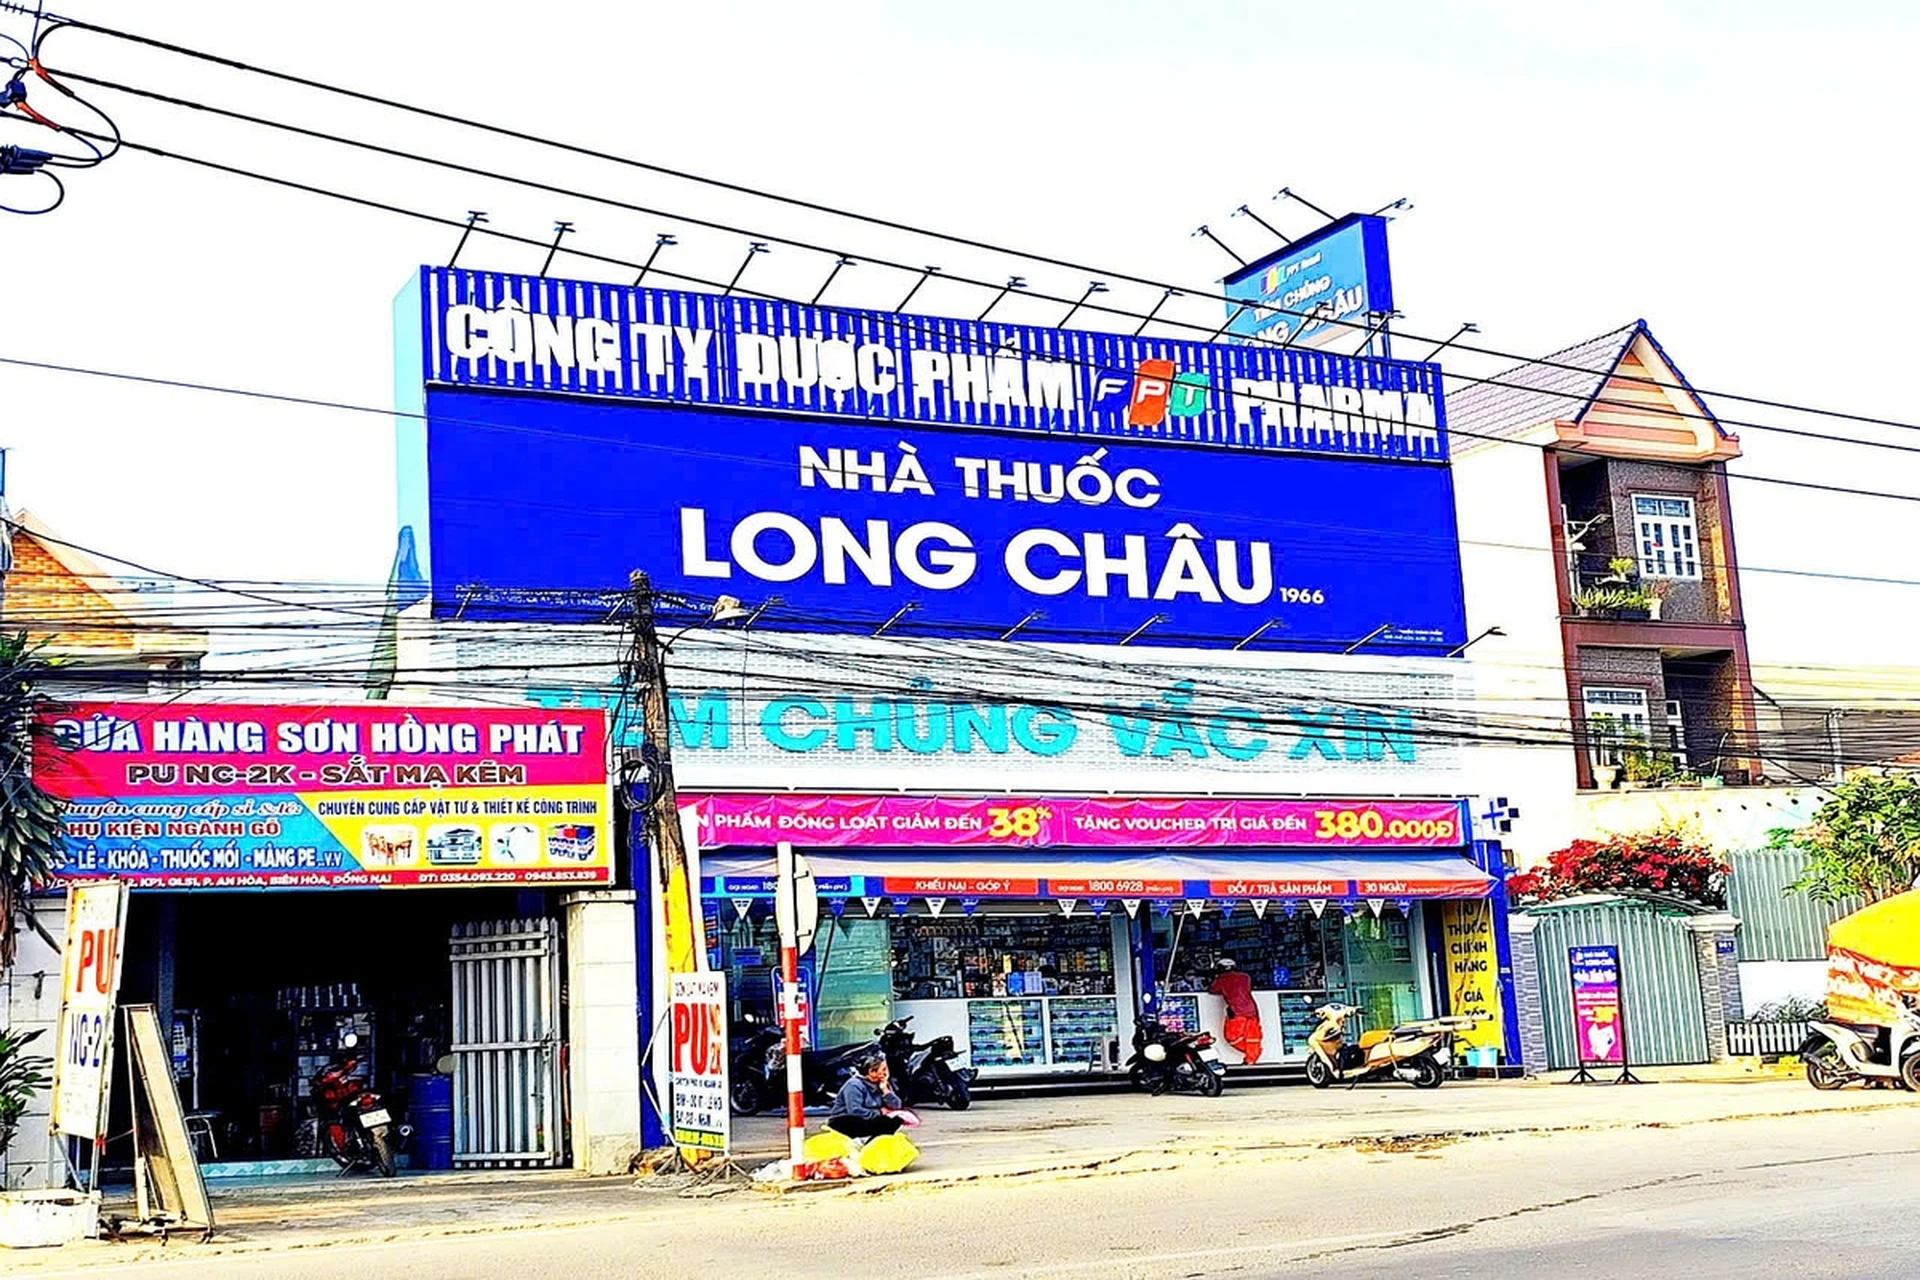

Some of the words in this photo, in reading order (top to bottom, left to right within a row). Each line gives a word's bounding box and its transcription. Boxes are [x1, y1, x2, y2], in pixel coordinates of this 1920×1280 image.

[446, 298, 620, 373] CÔNG
[631, 323, 713, 379] TY
[911, 337, 1075, 411] PHẨM
[1231, 378, 1437, 438] PHARMA
[799, 441, 935, 496] NHÀ
[955, 447, 1161, 508] THUỐC
[679, 507, 977, 590] LONG
[1003, 522, 1274, 605] CHÂU
[1280, 586, 1325, 605] 1966
[761, 676, 1078, 756] CHỦNG
[1107, 680, 1269, 761] VẮC
[1285, 706, 1416, 763] XIN
[153, 716, 264, 752] HÀNG
[277, 718, 357, 754] SƠN
[371, 713, 477, 754] HỒNG
[488, 719, 584, 754] PHÁT
[128, 765, 176, 784] PU
[186, 765, 293, 784] NC-2K
[321, 755, 387, 784] SẮT
[396, 765, 448, 788] MẠ
[456, 760, 525, 784] KẼM
[368, 801, 400, 815] CUNG
[471, 801, 480, 814] &
[533, 797, 563, 814] CÔNG
[107, 820, 161, 840] KIỆN
[167, 820, 244, 837] NGÀNH
[839, 815, 889, 832] LOẠT
[892, 812, 940, 830] GIẢM
[1124, 817, 1207, 831] VOUCHER
[1239, 815, 1269, 831] GIÁ
[107, 845, 149, 869] KHÓA
[160, 840, 211, 869] THUỐC
[976, 879, 1001, 892] GÓP
[1088, 880, 1114, 892] 1800
[1115, 880, 1144, 892] 6928
[1364, 882, 1378, 893] 30
[76, 929, 118, 994] PU
[1463, 987, 1485, 1002] GIÁ
[674, 1003, 709, 1076] PU
